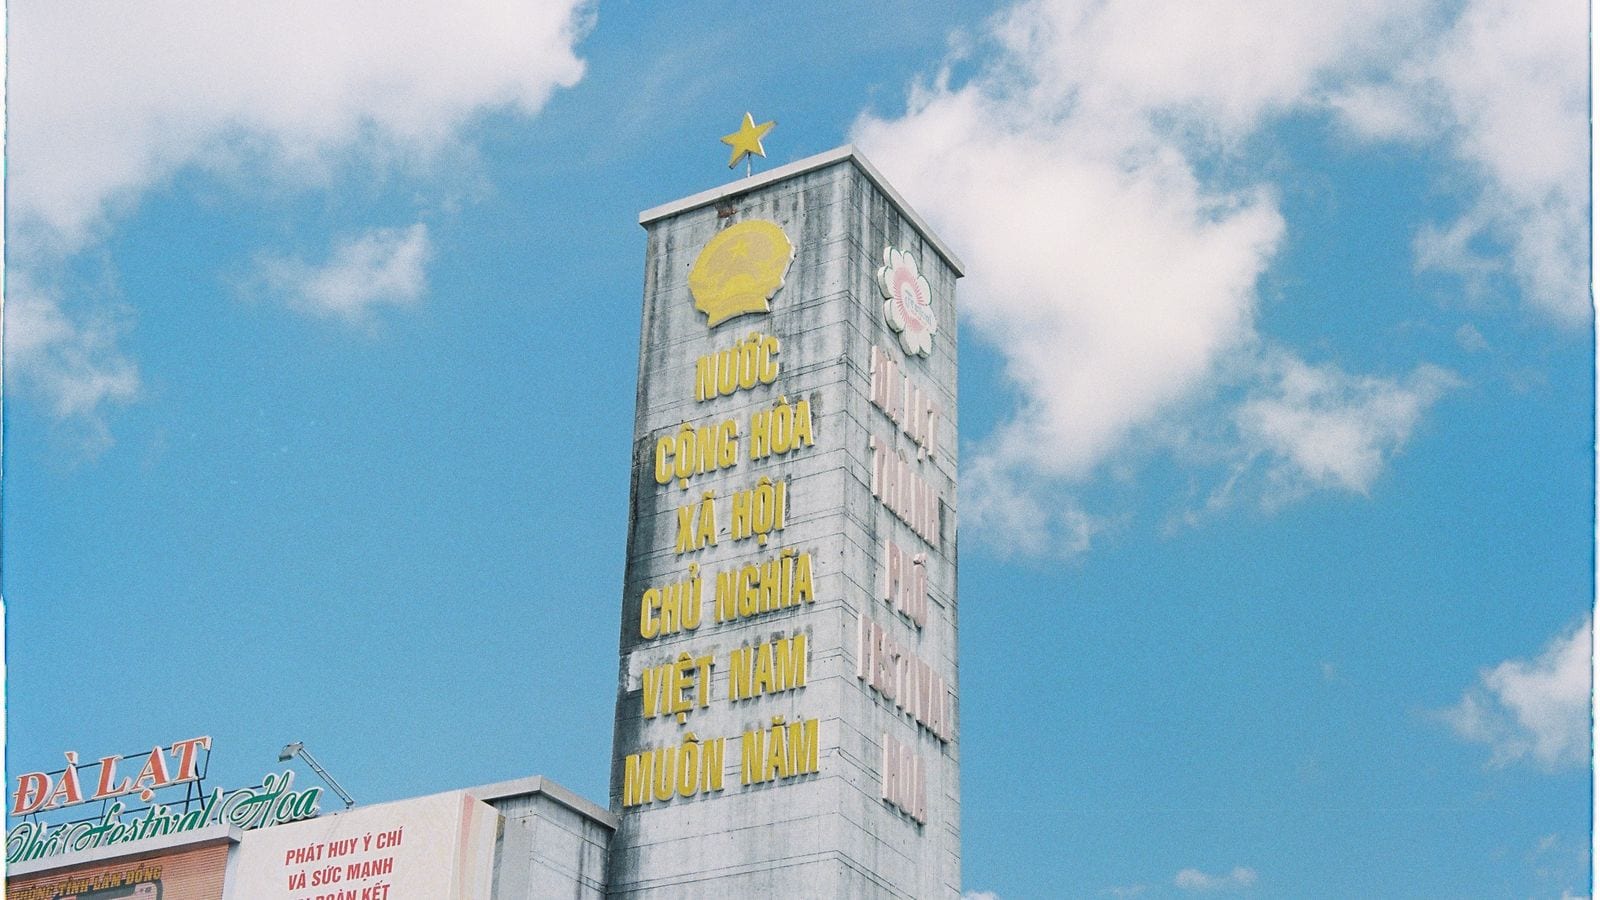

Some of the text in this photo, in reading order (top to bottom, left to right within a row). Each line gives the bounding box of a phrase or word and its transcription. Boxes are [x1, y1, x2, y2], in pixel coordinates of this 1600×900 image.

[695, 331, 781, 402] NƯỚC
[655, 394, 815, 490] CỘNG HÒA
[674, 475, 786, 555] XÃ HỘI
[869, 434, 941, 549] THÀNH
[640, 548, 816, 640] CHỦ NGHĨA
[641, 633, 808, 725] VIỆT NAM
[857, 612, 951, 744] FESTIVAL
[11, 736, 213, 816] ĐÀ LẠT
[219, 770, 324, 829] Hoa
[623, 714, 820, 808] MUÔN NĂM
[882, 731, 927, 825] HOA
[285, 826, 404, 866] PHÁT HUY Ý CHÍ
[288, 857, 394, 891] VÀ SỨC MẠNH
